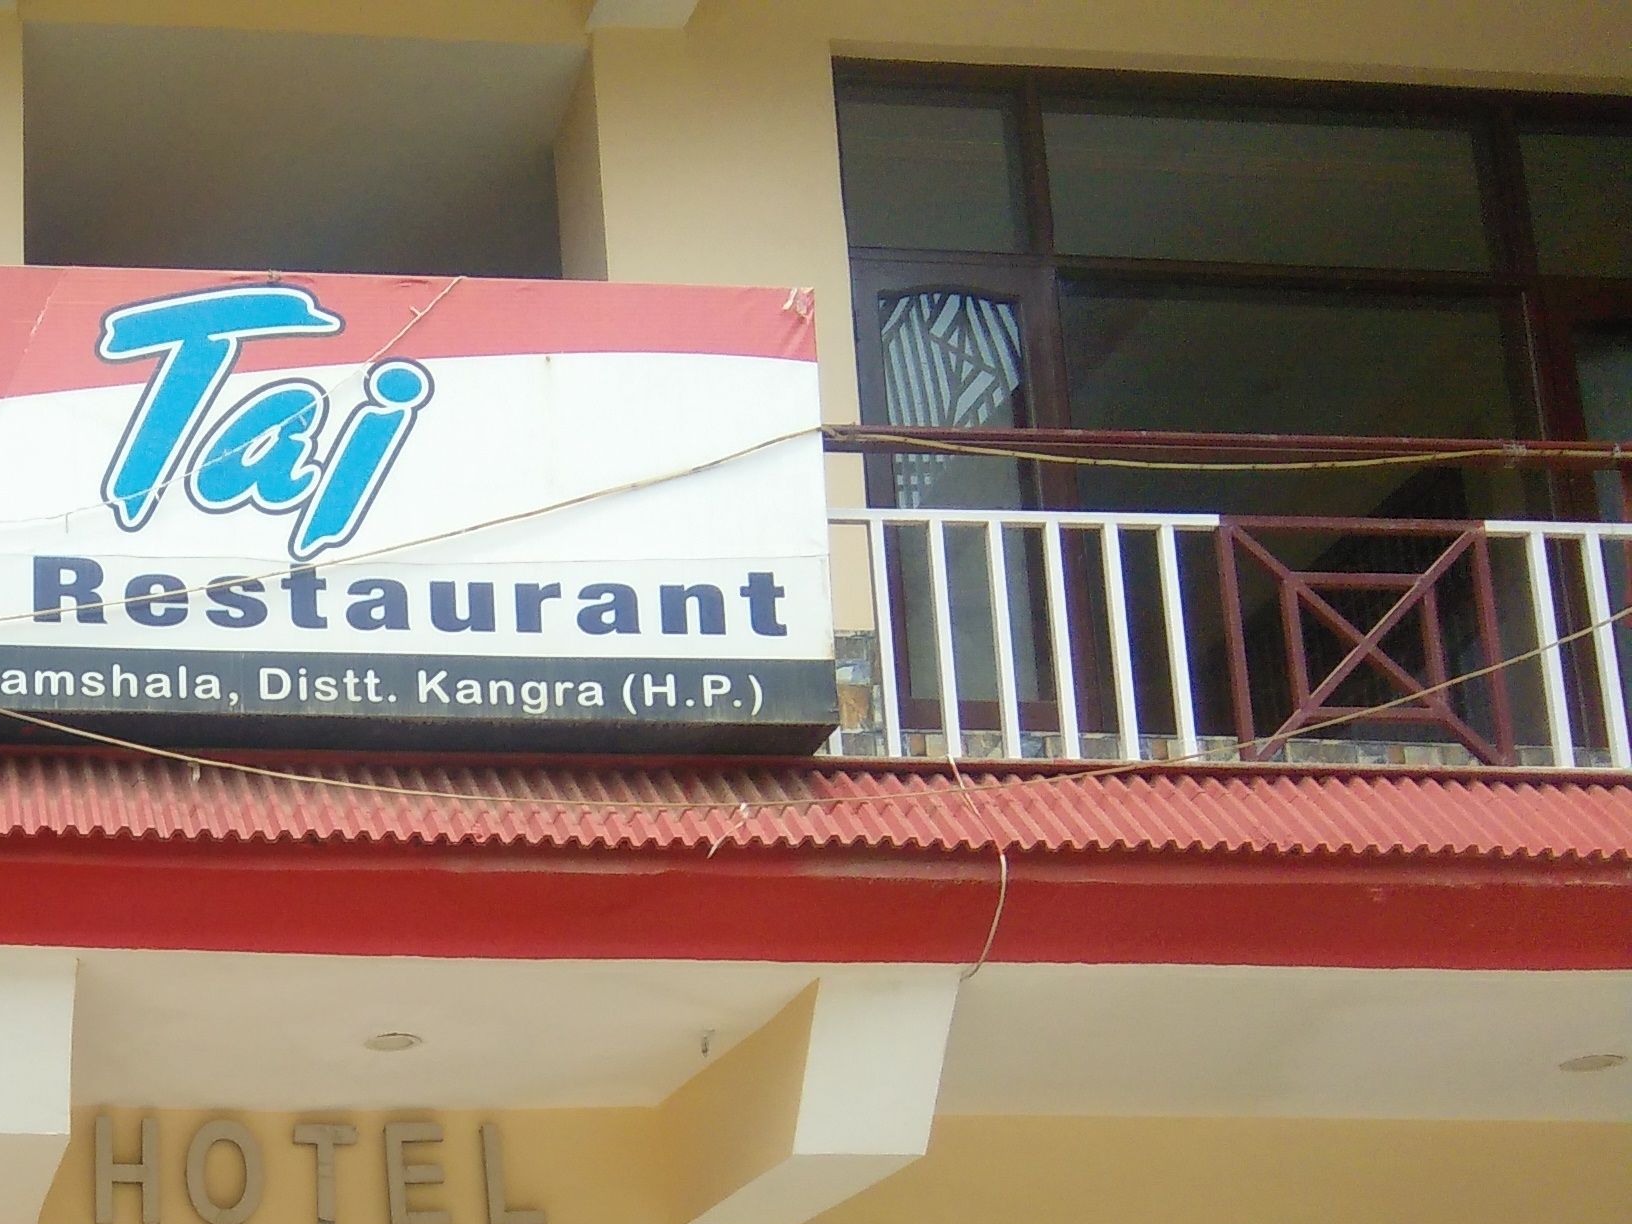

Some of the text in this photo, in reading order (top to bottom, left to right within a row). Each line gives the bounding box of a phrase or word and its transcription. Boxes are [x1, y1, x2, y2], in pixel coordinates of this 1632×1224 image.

[96, 282, 435, 560] Taj
[32, 554, 788, 638] Restaurant
[258, 667, 399, 706] Distt.
[417, 670, 606, 713] Kangra
[620, 671, 766, 716] (H.P.)
